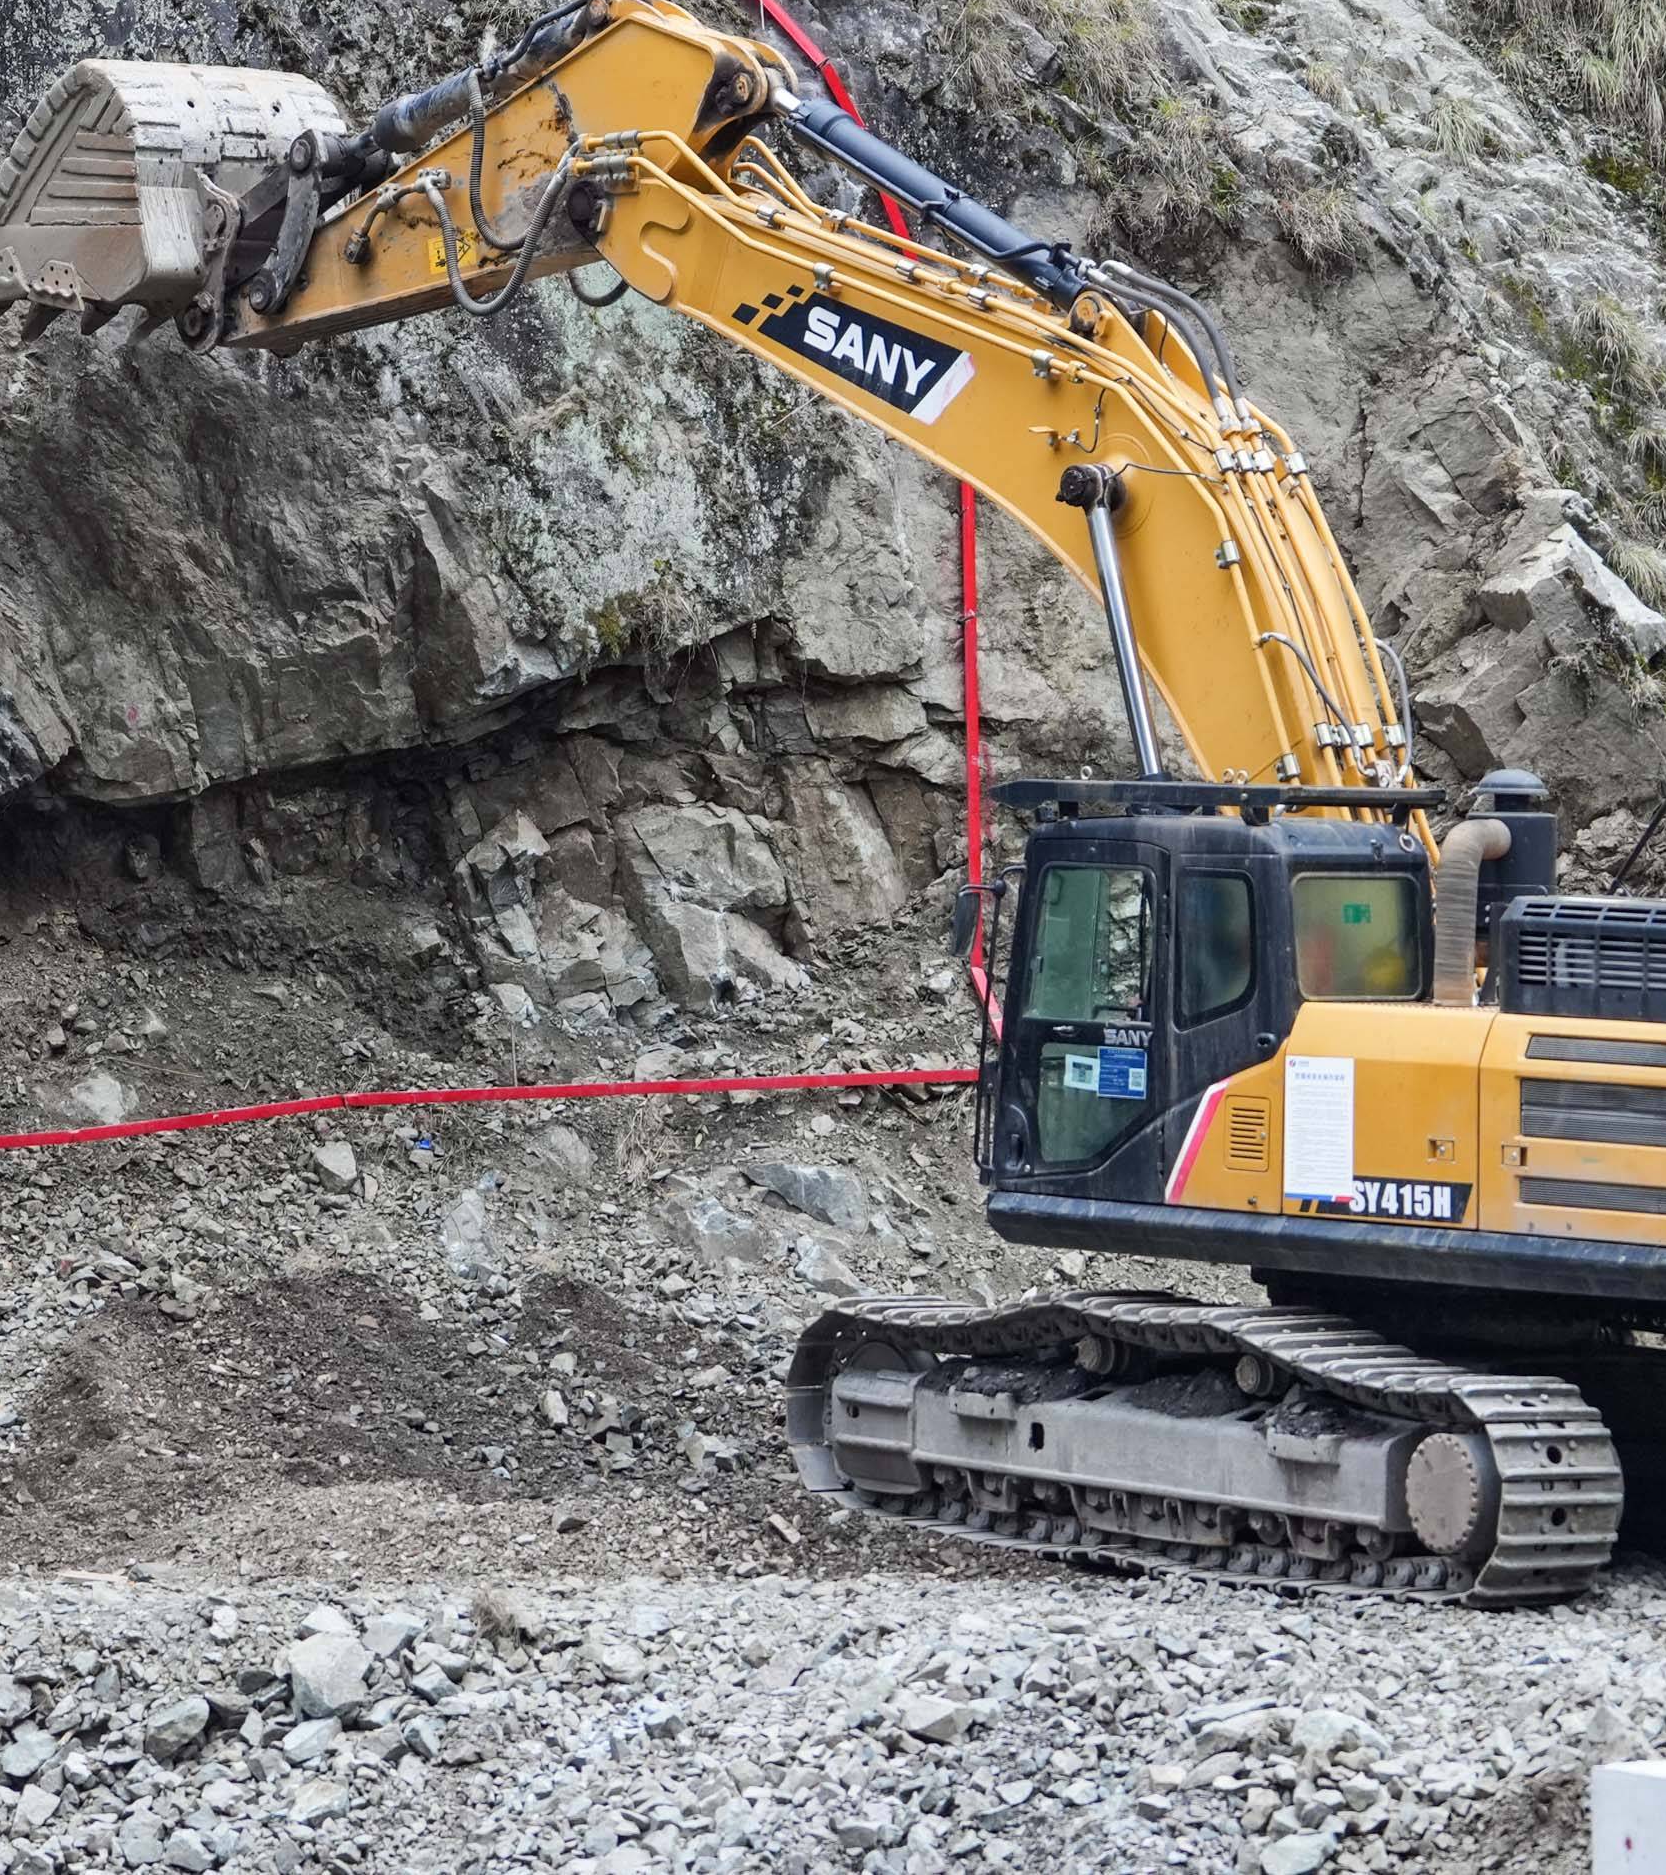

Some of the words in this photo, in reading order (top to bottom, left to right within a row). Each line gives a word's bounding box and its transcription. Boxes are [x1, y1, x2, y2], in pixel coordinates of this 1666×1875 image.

[803, 306, 936, 396] SANY
[1103, 1028, 1153, 1047] SANY
[1349, 1180, 1451, 1218] SY415H
